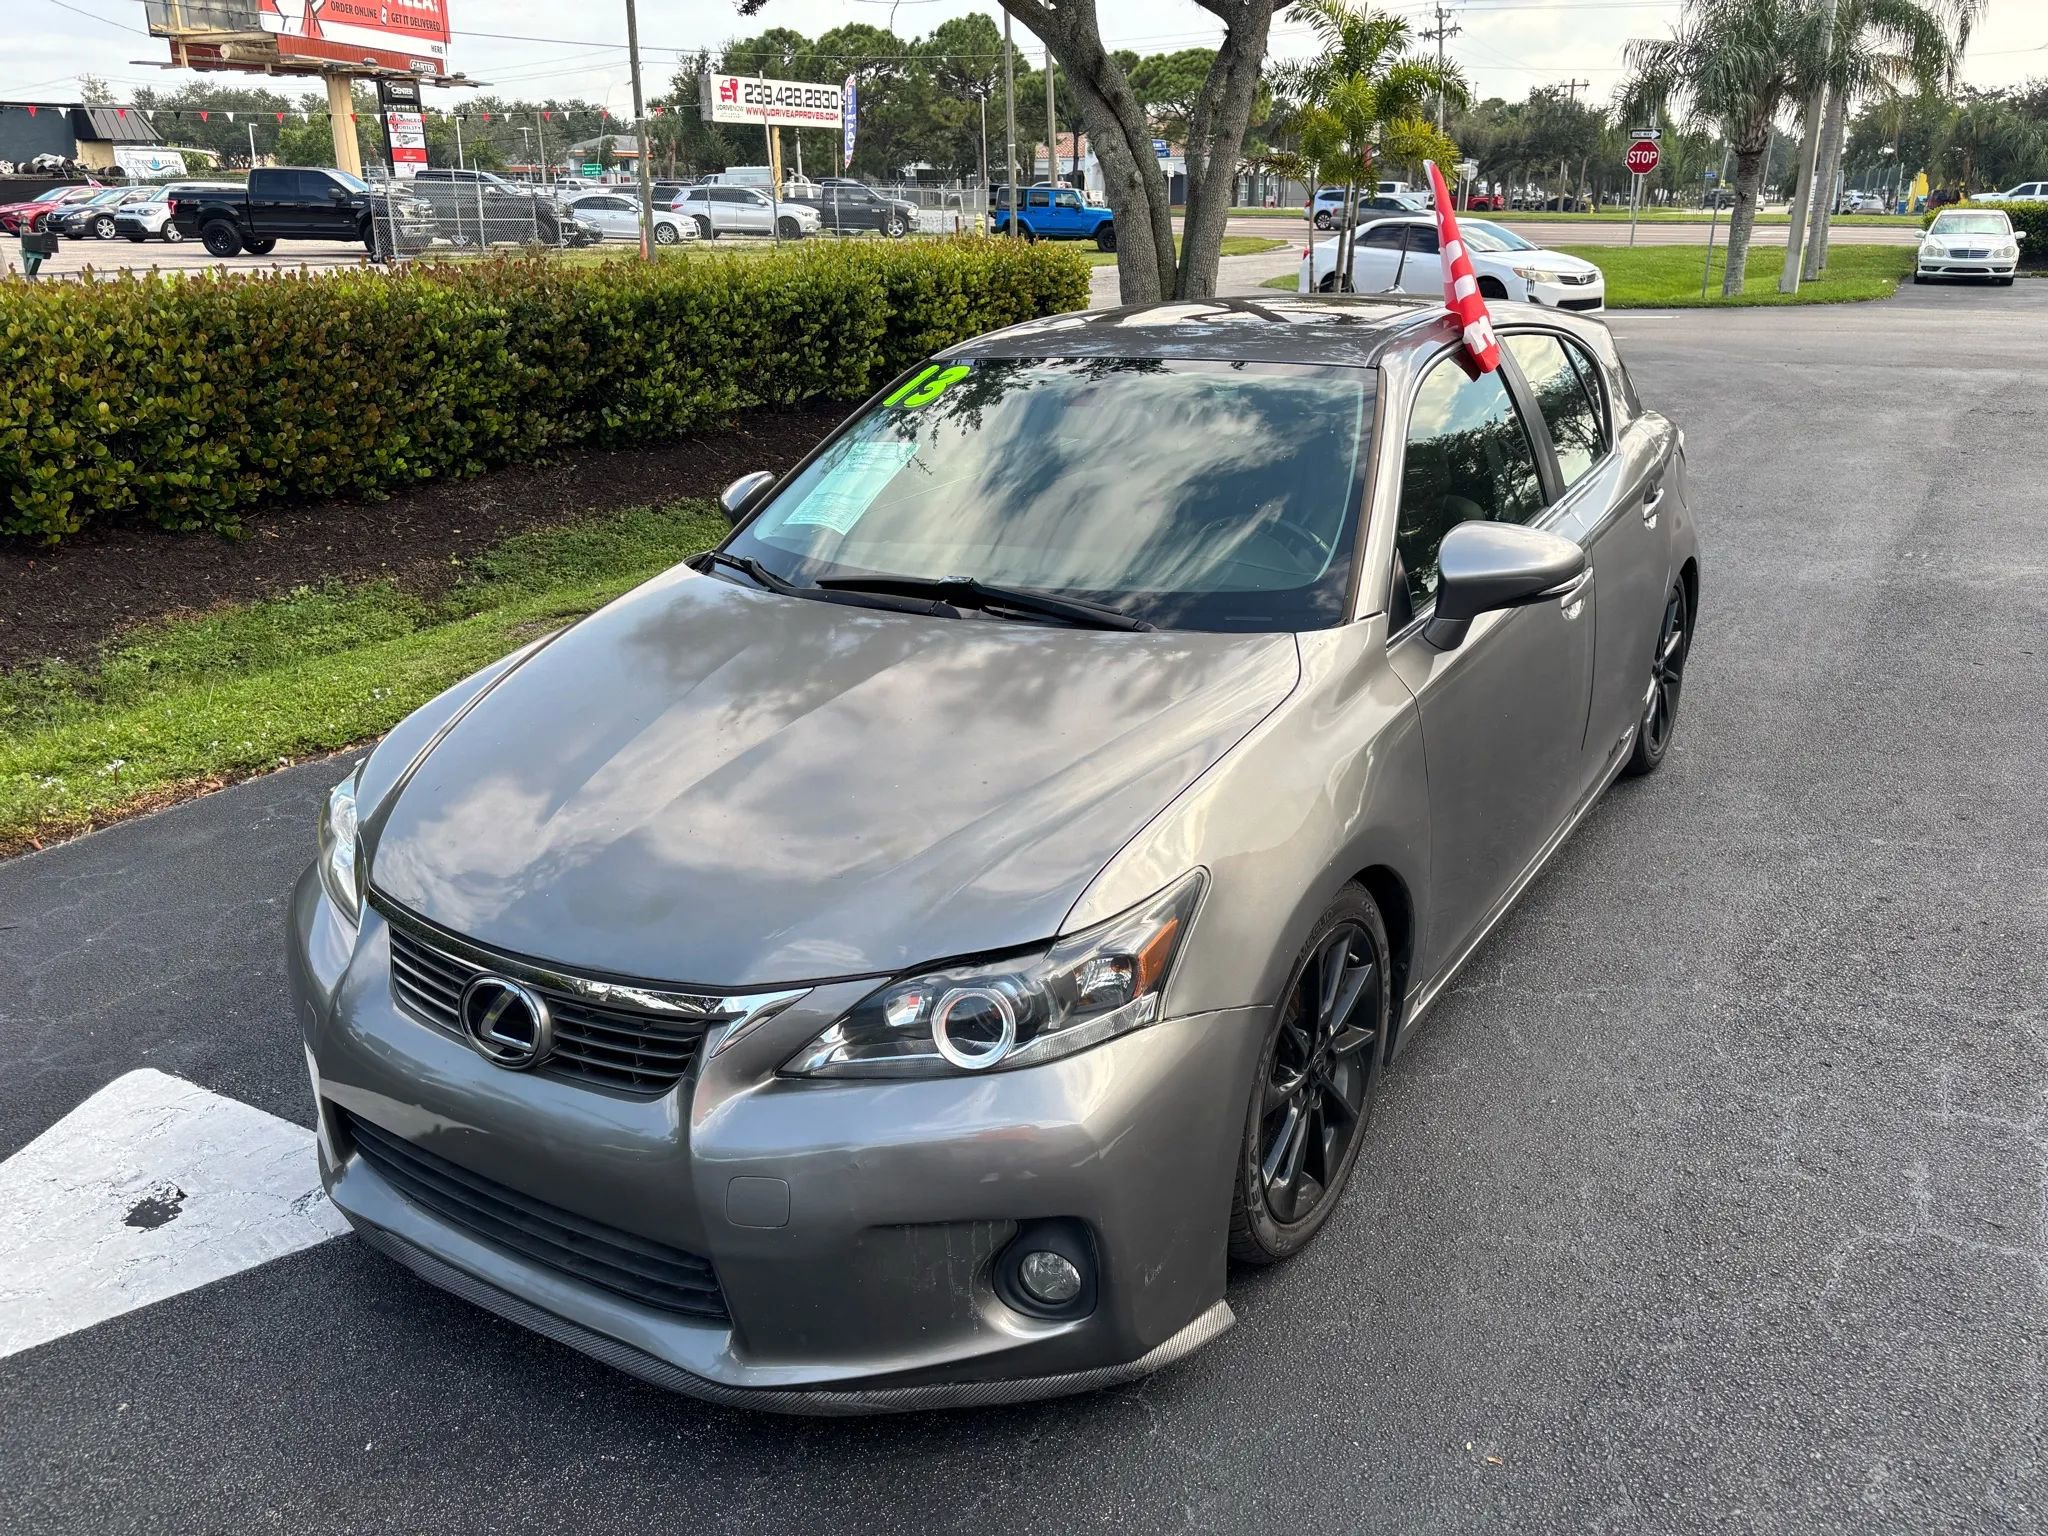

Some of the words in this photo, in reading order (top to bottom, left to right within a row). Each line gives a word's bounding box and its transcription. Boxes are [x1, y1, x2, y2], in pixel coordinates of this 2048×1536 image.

[331, 2, 353, 14] ORDER
[354, 6, 378, 19] ONLINE
[391, 13, 402, 23] GET
[403, 15, 409, 25] IT
[410, 17, 441, 31] DELIVERED
[431, 44, 443, 54] HERE
[744, 83, 839, 110] 239.428.2830
[745, 106, 839, 121] WWWUDRIVEAPPROVES.COM
[1628, 150, 1657, 164] STOP
[882, 364, 971, 409] 13
